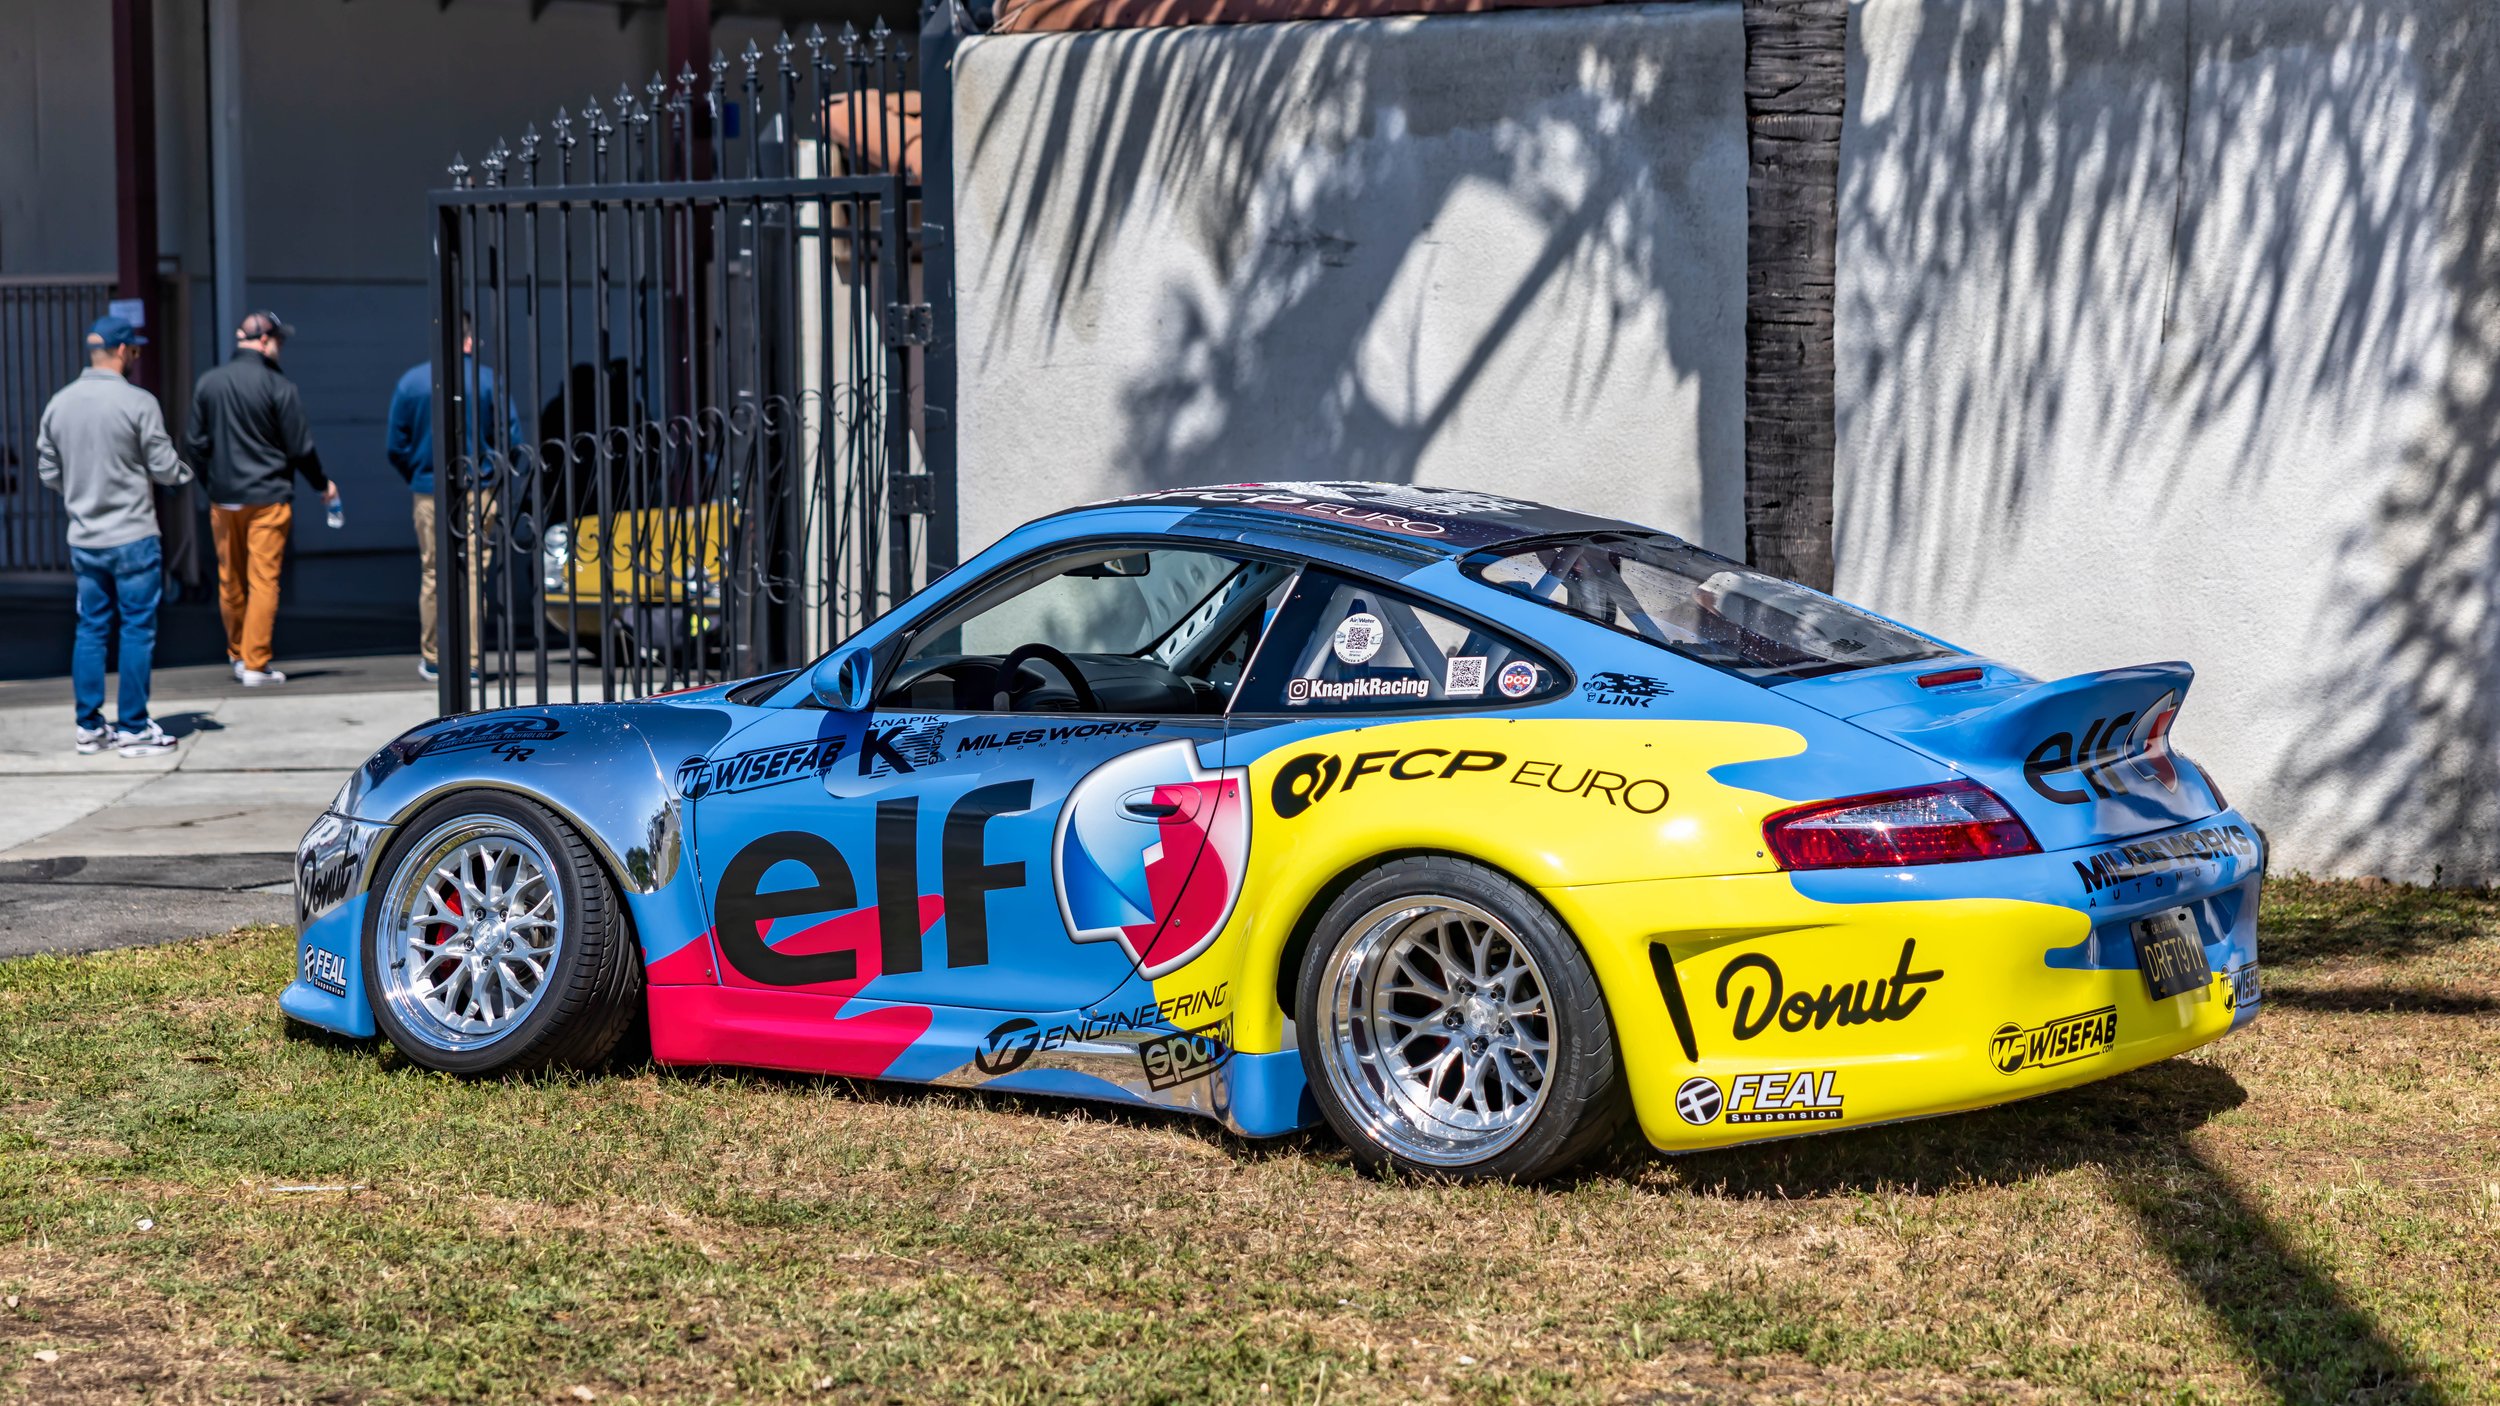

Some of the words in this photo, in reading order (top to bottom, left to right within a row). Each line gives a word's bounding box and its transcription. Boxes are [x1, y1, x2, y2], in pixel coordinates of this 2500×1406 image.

[1303, 502, 1446, 534] EURO
[1310, 676, 1430, 701] KnapikRacing
[1503, 674, 1532, 686] pca
[1596, 693, 1655, 708] LINK
[868, 714, 942, 729] KNAPIK
[927, 721, 949, 766] RACING
[955, 730, 1151, 760] AUTOMOTIVE
[714, 741, 846, 790] WISEFAB
[2023, 710, 2137, 805] elf
[1339, 748, 1508, 793] FCP
[1509, 760, 1670, 815] EURO
[300, 828, 359, 922] Donut
[714, 778, 1035, 987] elf
[2089, 858, 2254, 909] AUTOMOTIVE
[314, 947, 347, 987] FEAL
[2143, 933, 2204, 983] DRFT911
[1715, 937, 1945, 1041] Donut
[1040, 981, 1229, 1053] ENGINEERING
[2028, 1012, 2118, 1063] WISEFAB
[1726, 1071, 1844, 1112] FEAL
[1730, 1110, 1838, 1123] Suspension
